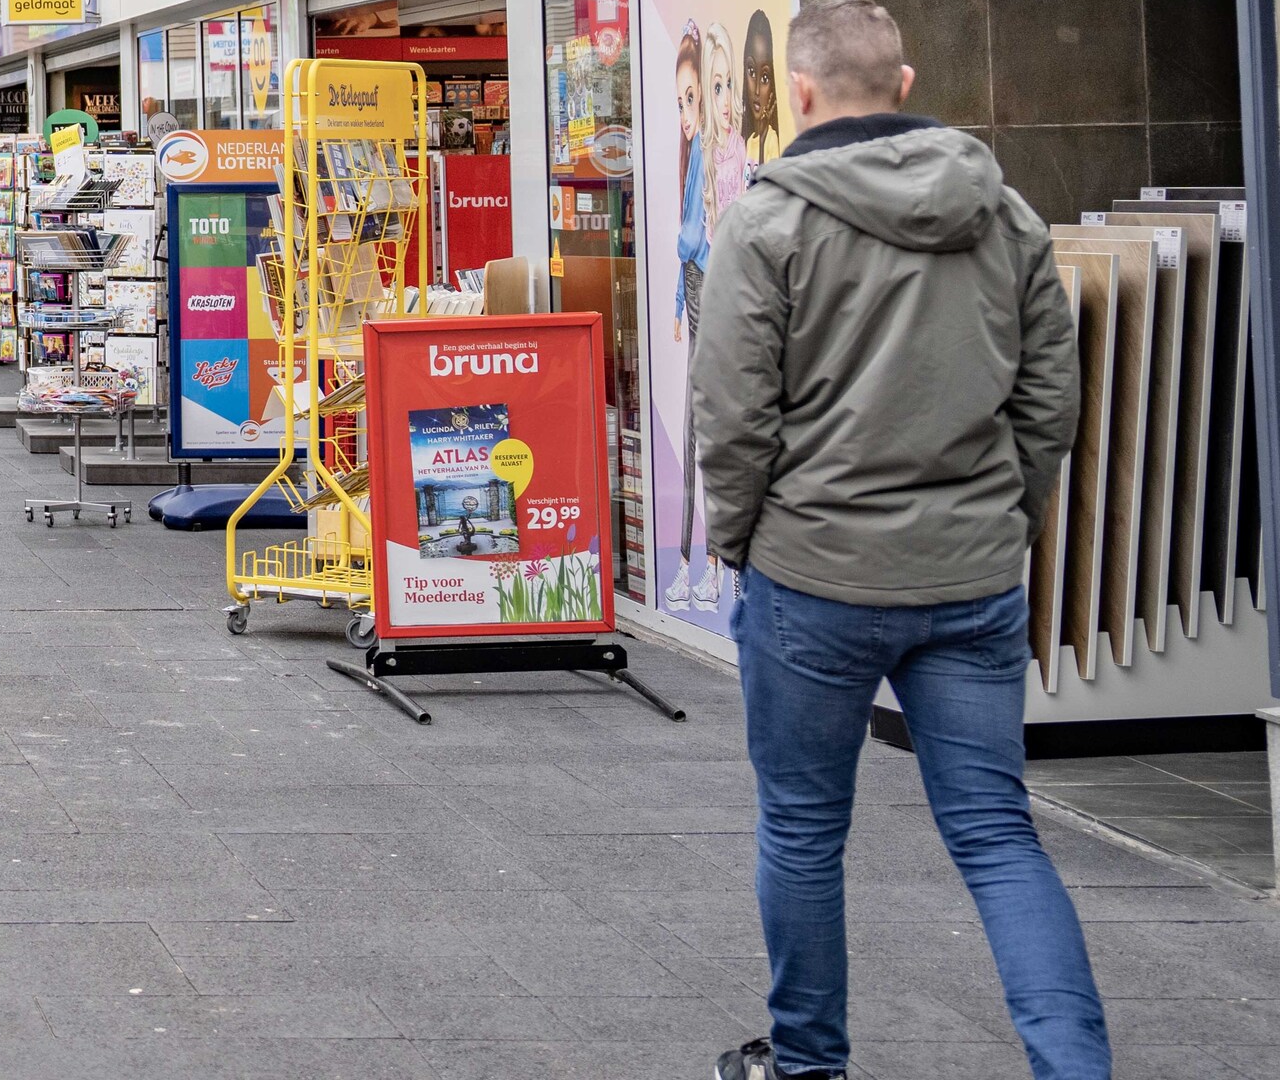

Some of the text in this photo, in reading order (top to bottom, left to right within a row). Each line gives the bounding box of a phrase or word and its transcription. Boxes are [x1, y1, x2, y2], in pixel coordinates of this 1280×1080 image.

[409, 46, 456, 54] Wenskaarten
[84, 94, 119, 106] WEEK
[328, 83, 379, 111] De Telegraaf
[327, 119, 333, 127] De
[363, 119, 385, 128] Nederland
[449, 191, 508, 208] bruna
[189, 218, 229, 234] TOTO
[190, 297, 233, 308] KRASLOTEN
[458, 343, 476, 352] goed
[476, 342, 503, 350] verhaal
[504, 342, 527, 351] begint
[528, 341, 538, 350] bij
[429, 345, 539, 377] bruna
[193, 358, 238, 381] Lucky
[201, 371, 233, 389] Day
[422, 426, 455, 434] LUCINDA
[427, 433, 494, 444] HARRY WHITTAKER
[432, 446, 489, 465] ATLAS
[494, 453, 528, 461] RESERVEER
[433, 466, 463, 474] VERHAAL
[526, 496, 579, 505] Verschijnt 11 mei
[527, 506, 580, 530] 29.99
[404, 577, 464, 591] Tip voor
[404, 590, 485, 604] Moederdag
